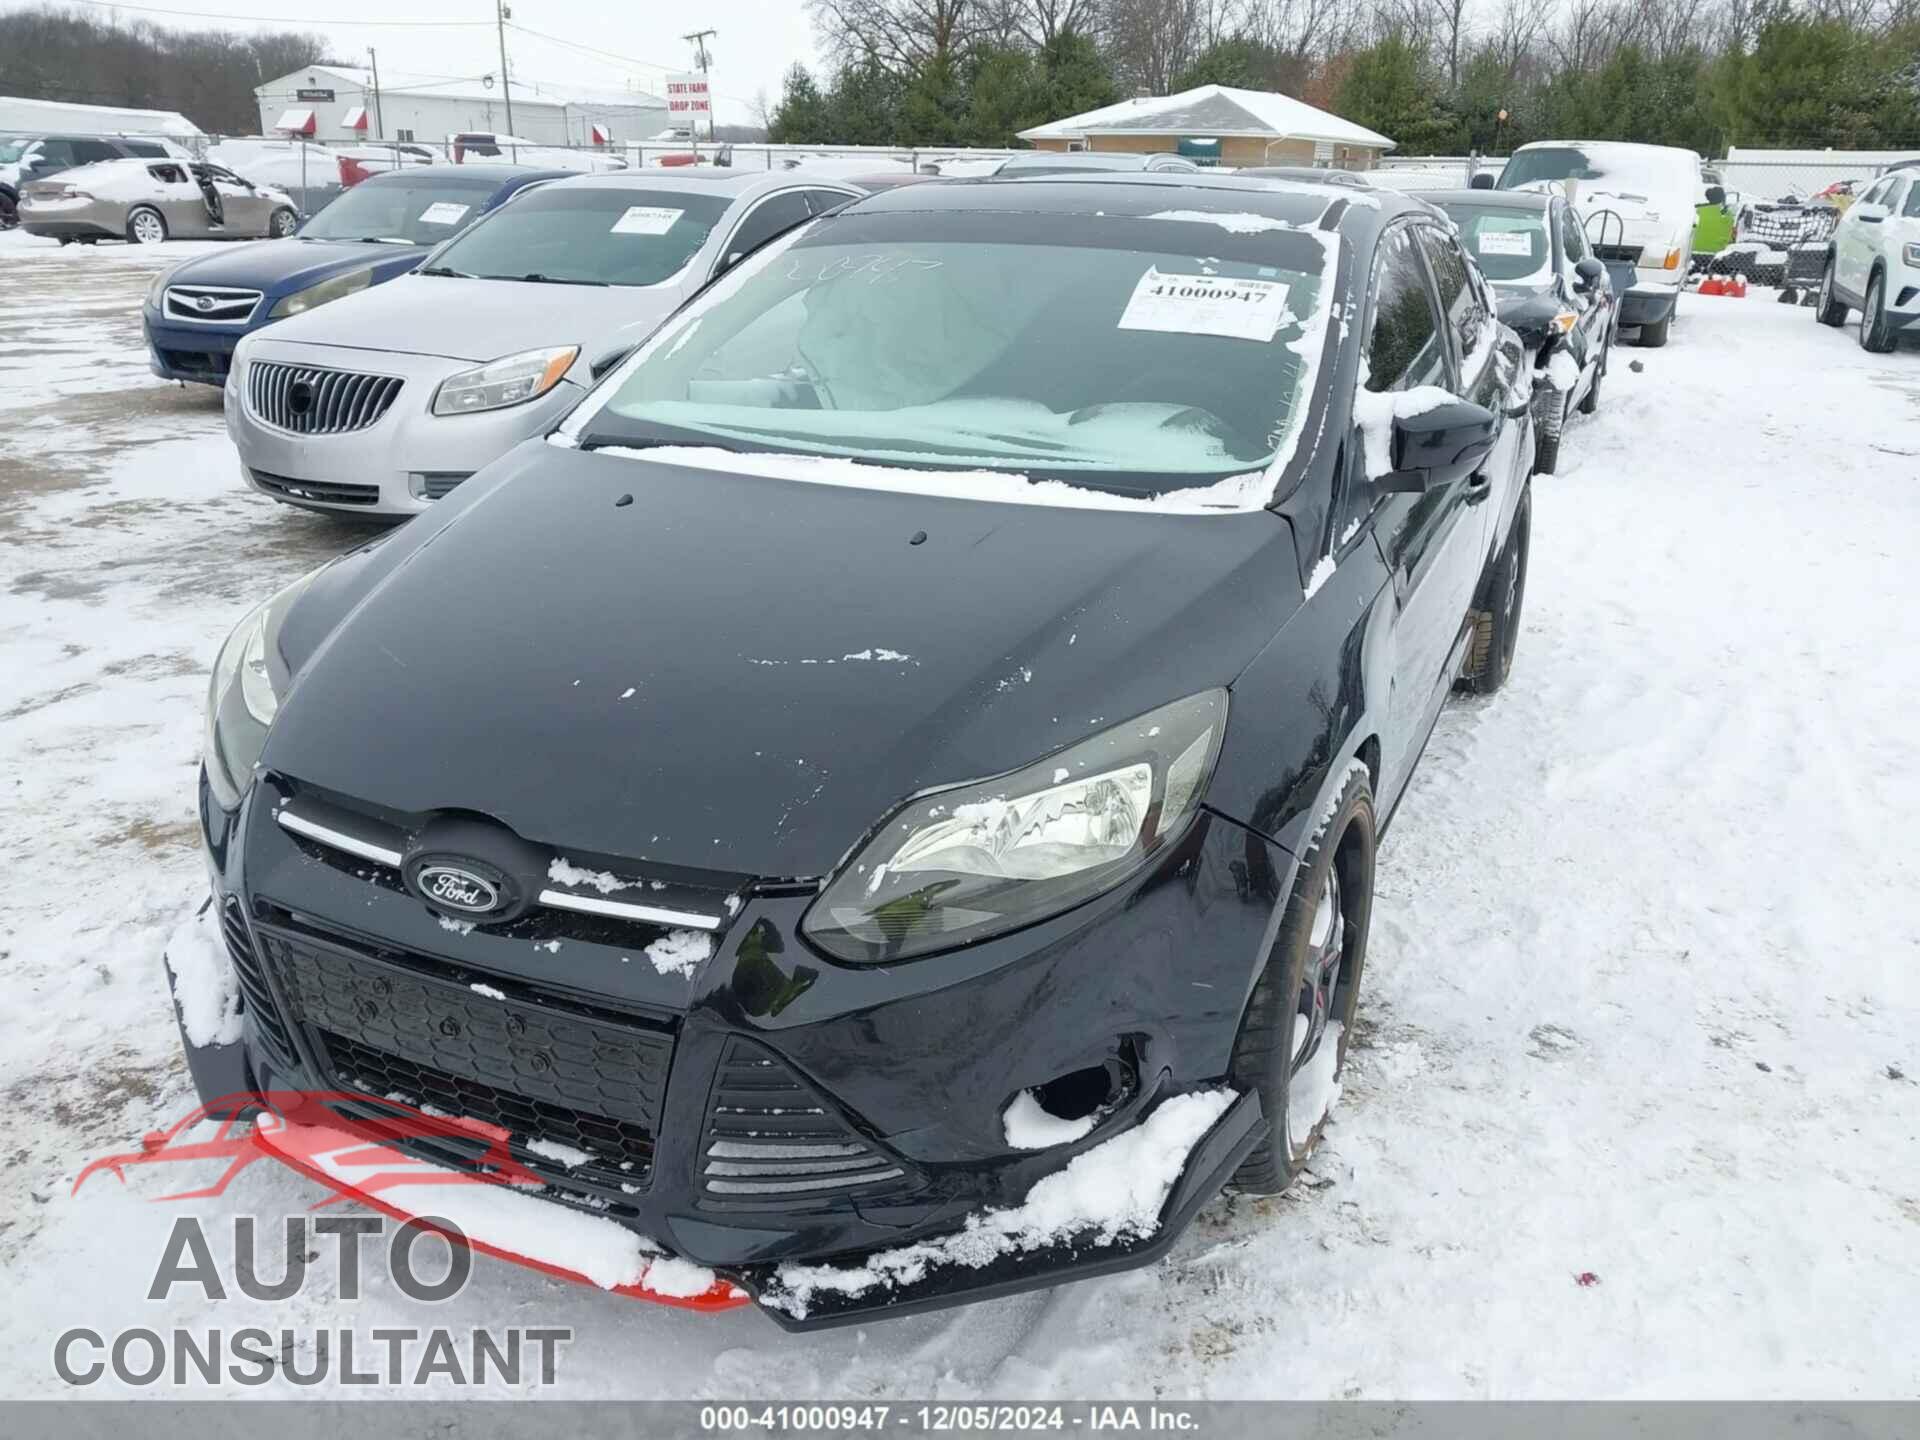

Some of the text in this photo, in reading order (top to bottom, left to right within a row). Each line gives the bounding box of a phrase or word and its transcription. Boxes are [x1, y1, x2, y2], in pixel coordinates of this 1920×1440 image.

[667, 83, 688, 94] STATE
[669, 101, 709, 111] DROP ZONE
[1150, 285, 1267, 303] 41000947
[433, 874, 480, 904] Ford
